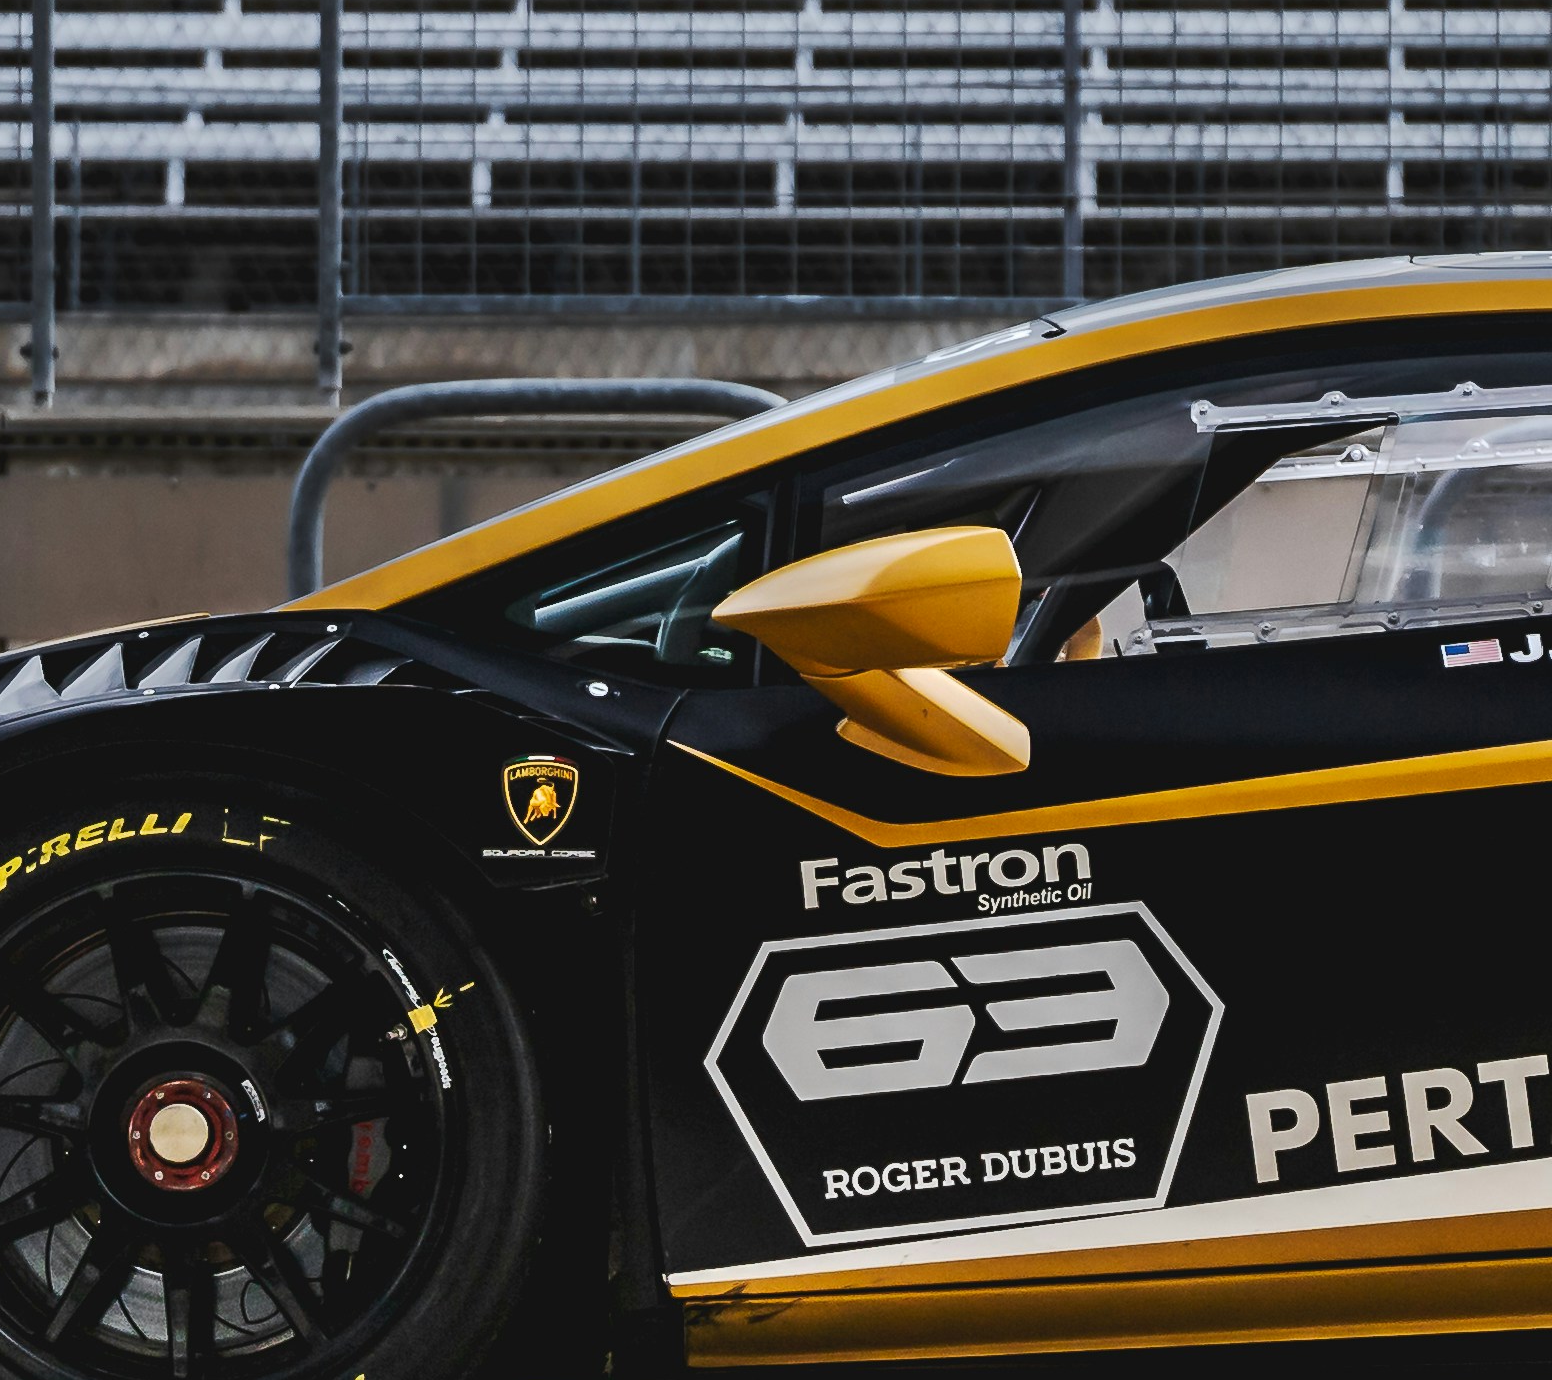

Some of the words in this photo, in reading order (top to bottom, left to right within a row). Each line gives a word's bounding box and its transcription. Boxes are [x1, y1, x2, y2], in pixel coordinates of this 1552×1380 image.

[509, 767, 573, 781] LAMBORGHINI
[799, 843, 1093, 910] Fastron
[977, 886, 1062, 914] Synthetic
[1067, 882, 1093, 901] Oil
[762, 939, 1171, 1102] 63
[822, 1156, 972, 1200] ROGER
[980, 1137, 1137, 1183] DUBUIS
